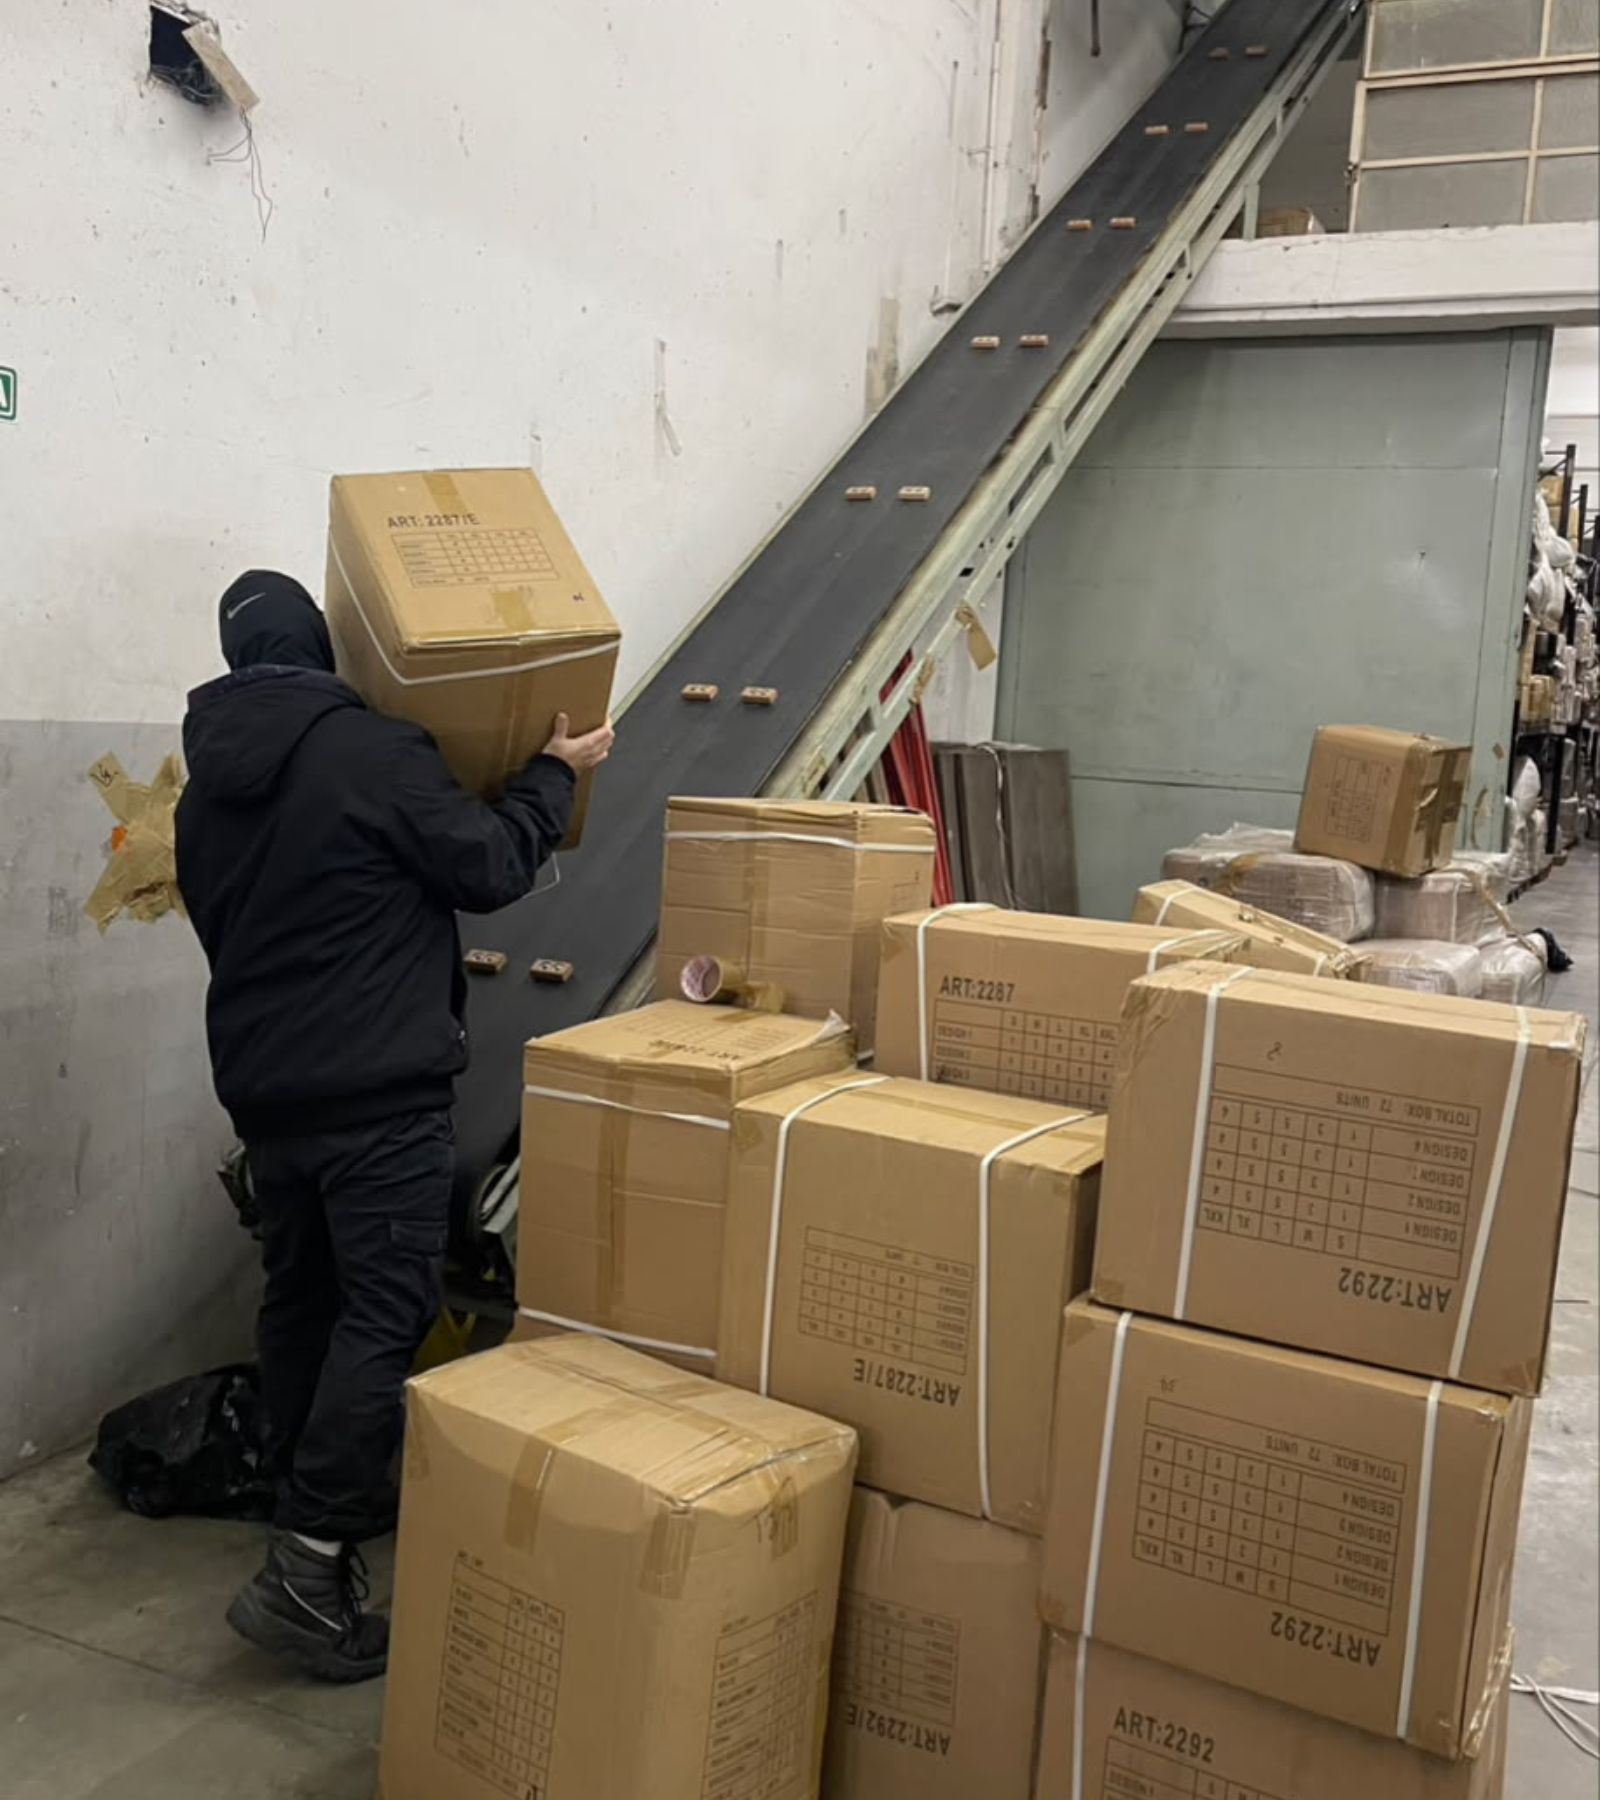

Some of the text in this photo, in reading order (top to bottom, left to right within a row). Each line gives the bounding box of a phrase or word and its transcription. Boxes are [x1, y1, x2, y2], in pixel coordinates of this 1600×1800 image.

[939, 974, 1015, 1004] ART:2287
[1335, 1090, 1370, 1109] UNITS
[1422, 1141, 1467, 1161] DESIGN
[1418, 1167, 1464, 1188] DESIGN
[1202, 1207, 1223, 1222] XXL
[1415, 1194, 1461, 1215] DESIGN
[1235, 1213, 1250, 1229] XL
[1272, 1221, 1280, 1235] L
[1412, 1222, 1458, 1243] DESIGN
[1337, 1266, 1451, 1314] ART:2292
[1264, 1434, 1298, 1456] UNITS
[1307, 1446, 1321, 1462] 72
[1361, 1460, 1398, 1483] TOTAL
[1350, 1493, 1394, 1517] DESIGN
[1347, 1519, 1391, 1545] DESIGN
[1170, 1549, 1183, 1565] XL
[1205, 1559, 1213, 1572] L
[1344, 1547, 1389, 1572] DESIGN
[1342, 1574, 1386, 1600] DESIGN
[1269, 1609, 1380, 1669] ART:2292
[1113, 1706, 1215, 1763] ART:2292
